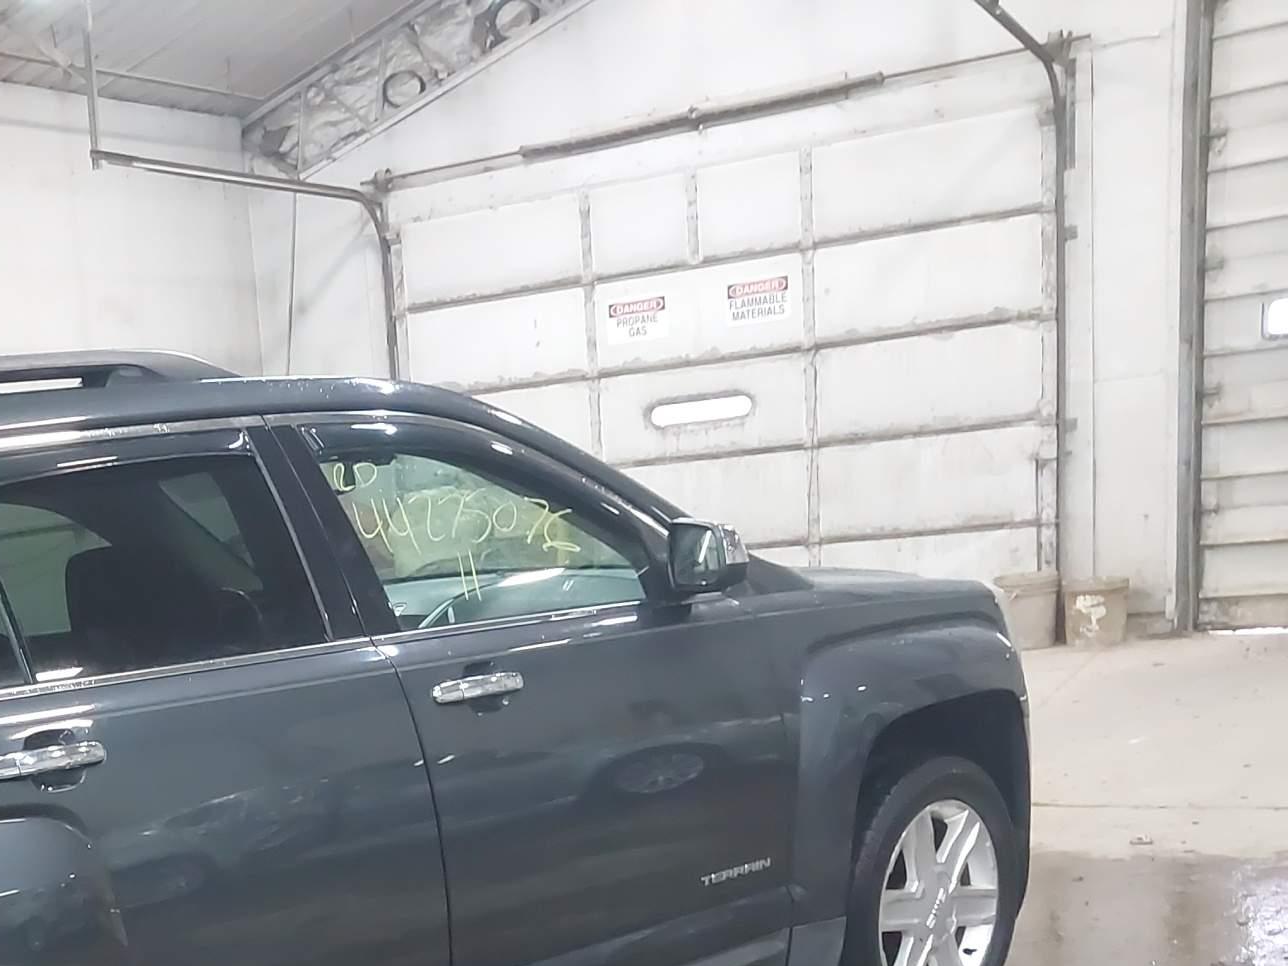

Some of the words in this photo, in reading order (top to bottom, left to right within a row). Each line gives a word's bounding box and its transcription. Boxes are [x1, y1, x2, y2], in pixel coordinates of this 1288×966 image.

[734, 279, 778, 297] DANGER
[615, 299, 657, 314] DANGER
[728, 292, 787, 311] FLAMMABLE
[616, 312, 658, 328] PROPANE
[732, 303, 785, 321] MATERIALS
[628, 325, 647, 338] GAS
[700, 857, 771, 886] TERRAIN
